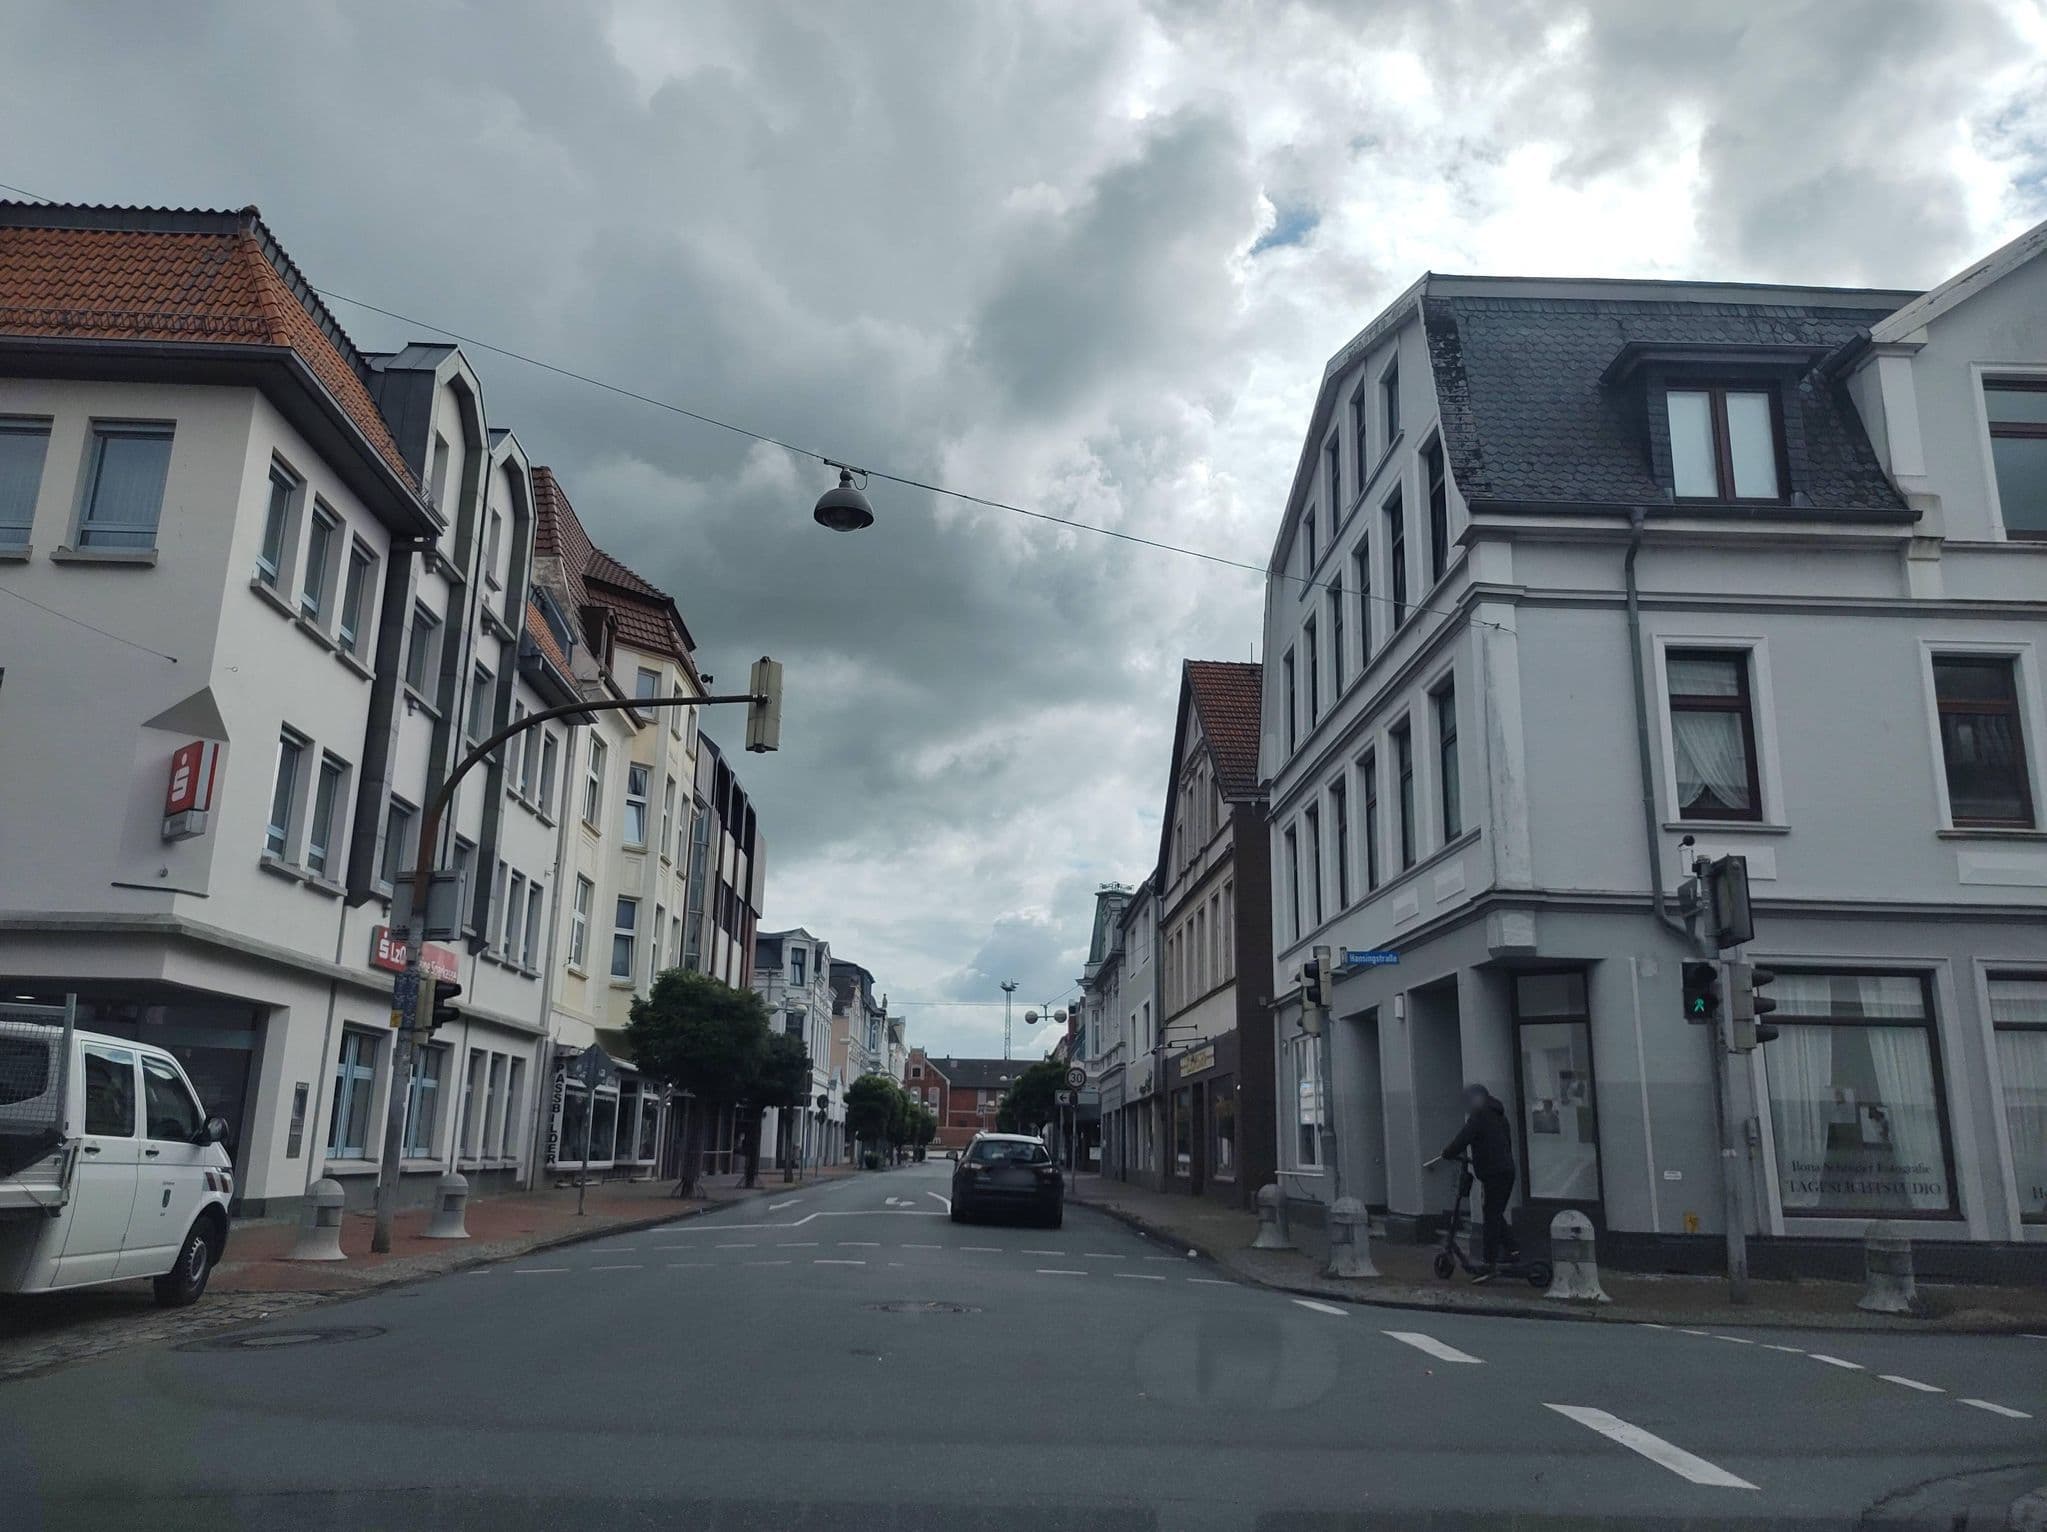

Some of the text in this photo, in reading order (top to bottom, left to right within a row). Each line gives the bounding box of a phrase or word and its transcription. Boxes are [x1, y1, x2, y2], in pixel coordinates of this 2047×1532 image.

[1071, 1073, 1082, 1083] 30
[547, 1063, 565, 1164] PASSBILDER
[1788, 1180, 1941, 1195] TAGESLICHTSTUDIO
